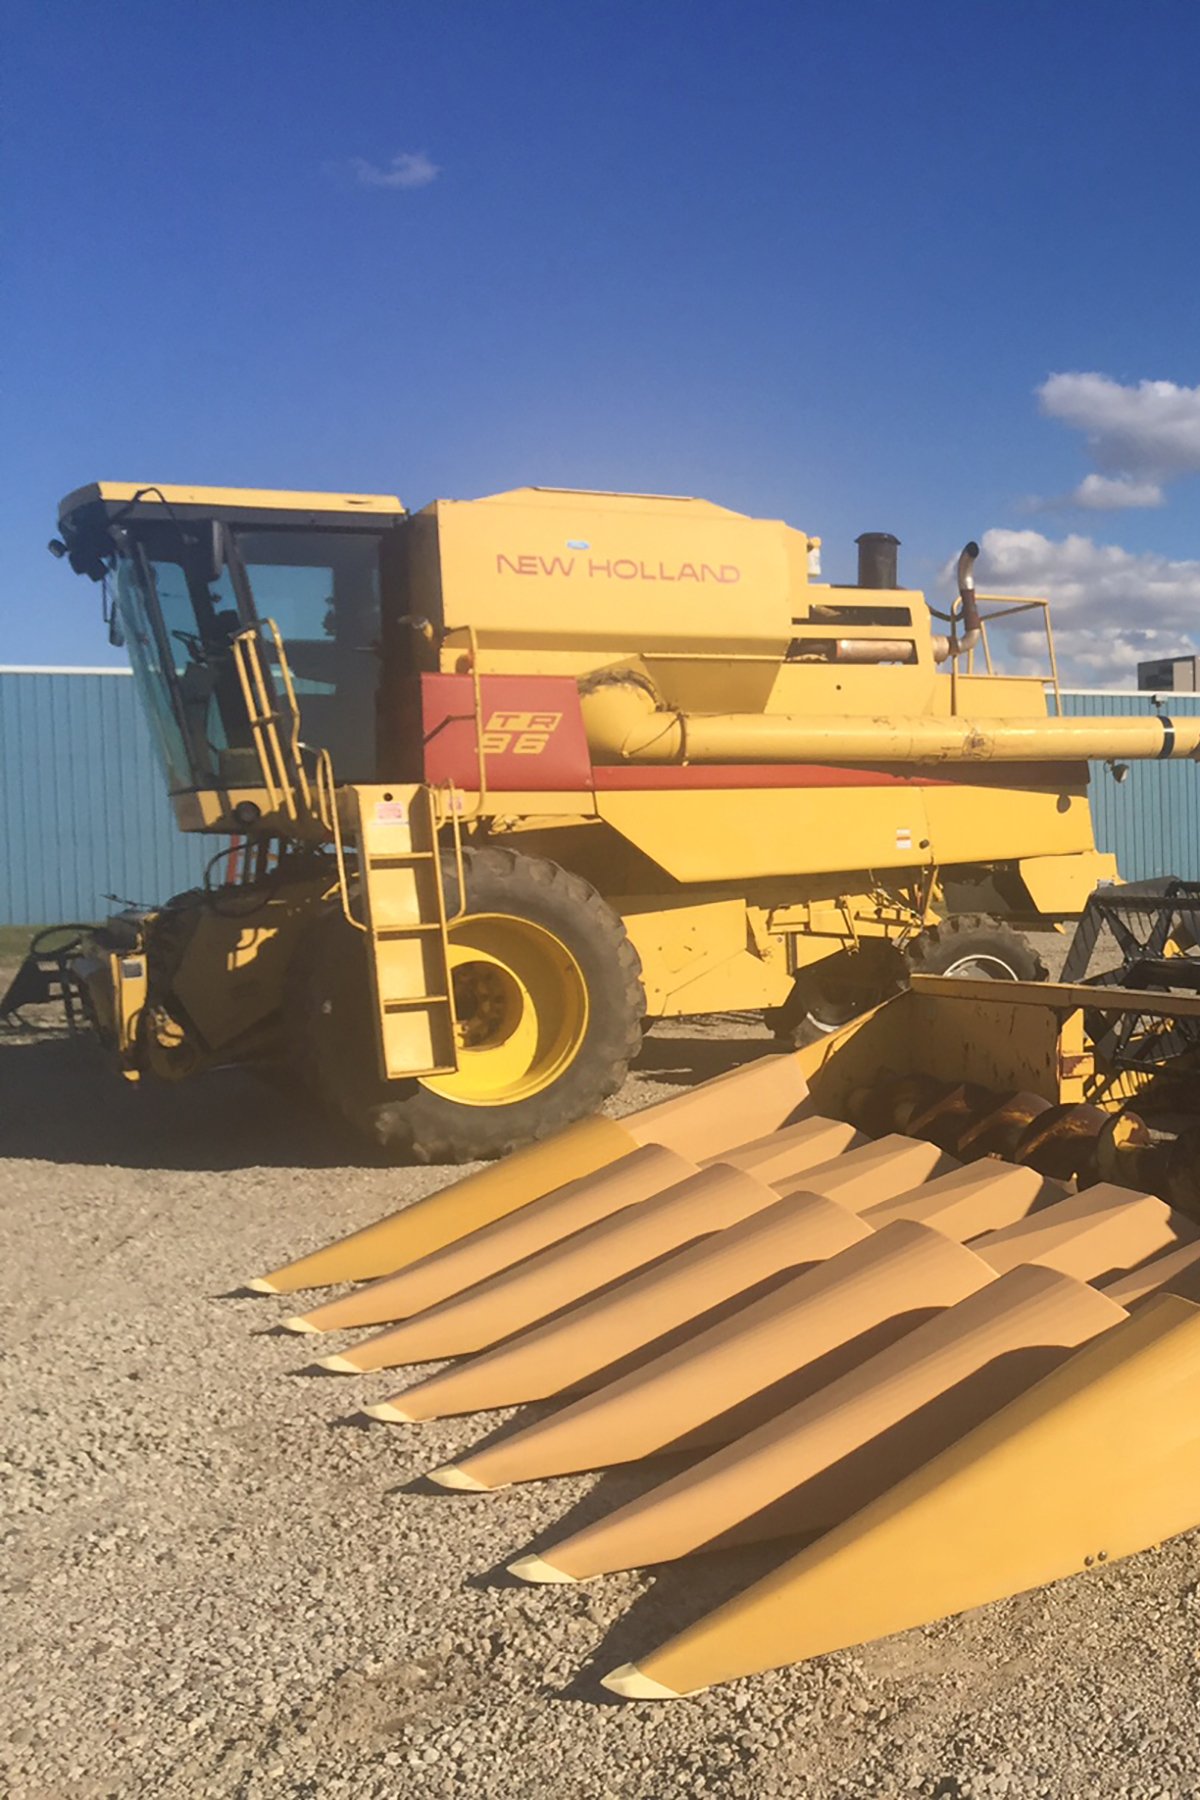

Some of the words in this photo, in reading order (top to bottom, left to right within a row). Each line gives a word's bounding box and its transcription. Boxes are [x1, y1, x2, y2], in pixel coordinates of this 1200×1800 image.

[496, 554, 576, 577] NEW
[588, 558, 741, 584] HOLLAND
[490, 713, 560, 730] TR
[481, 733, 550, 754] 96
